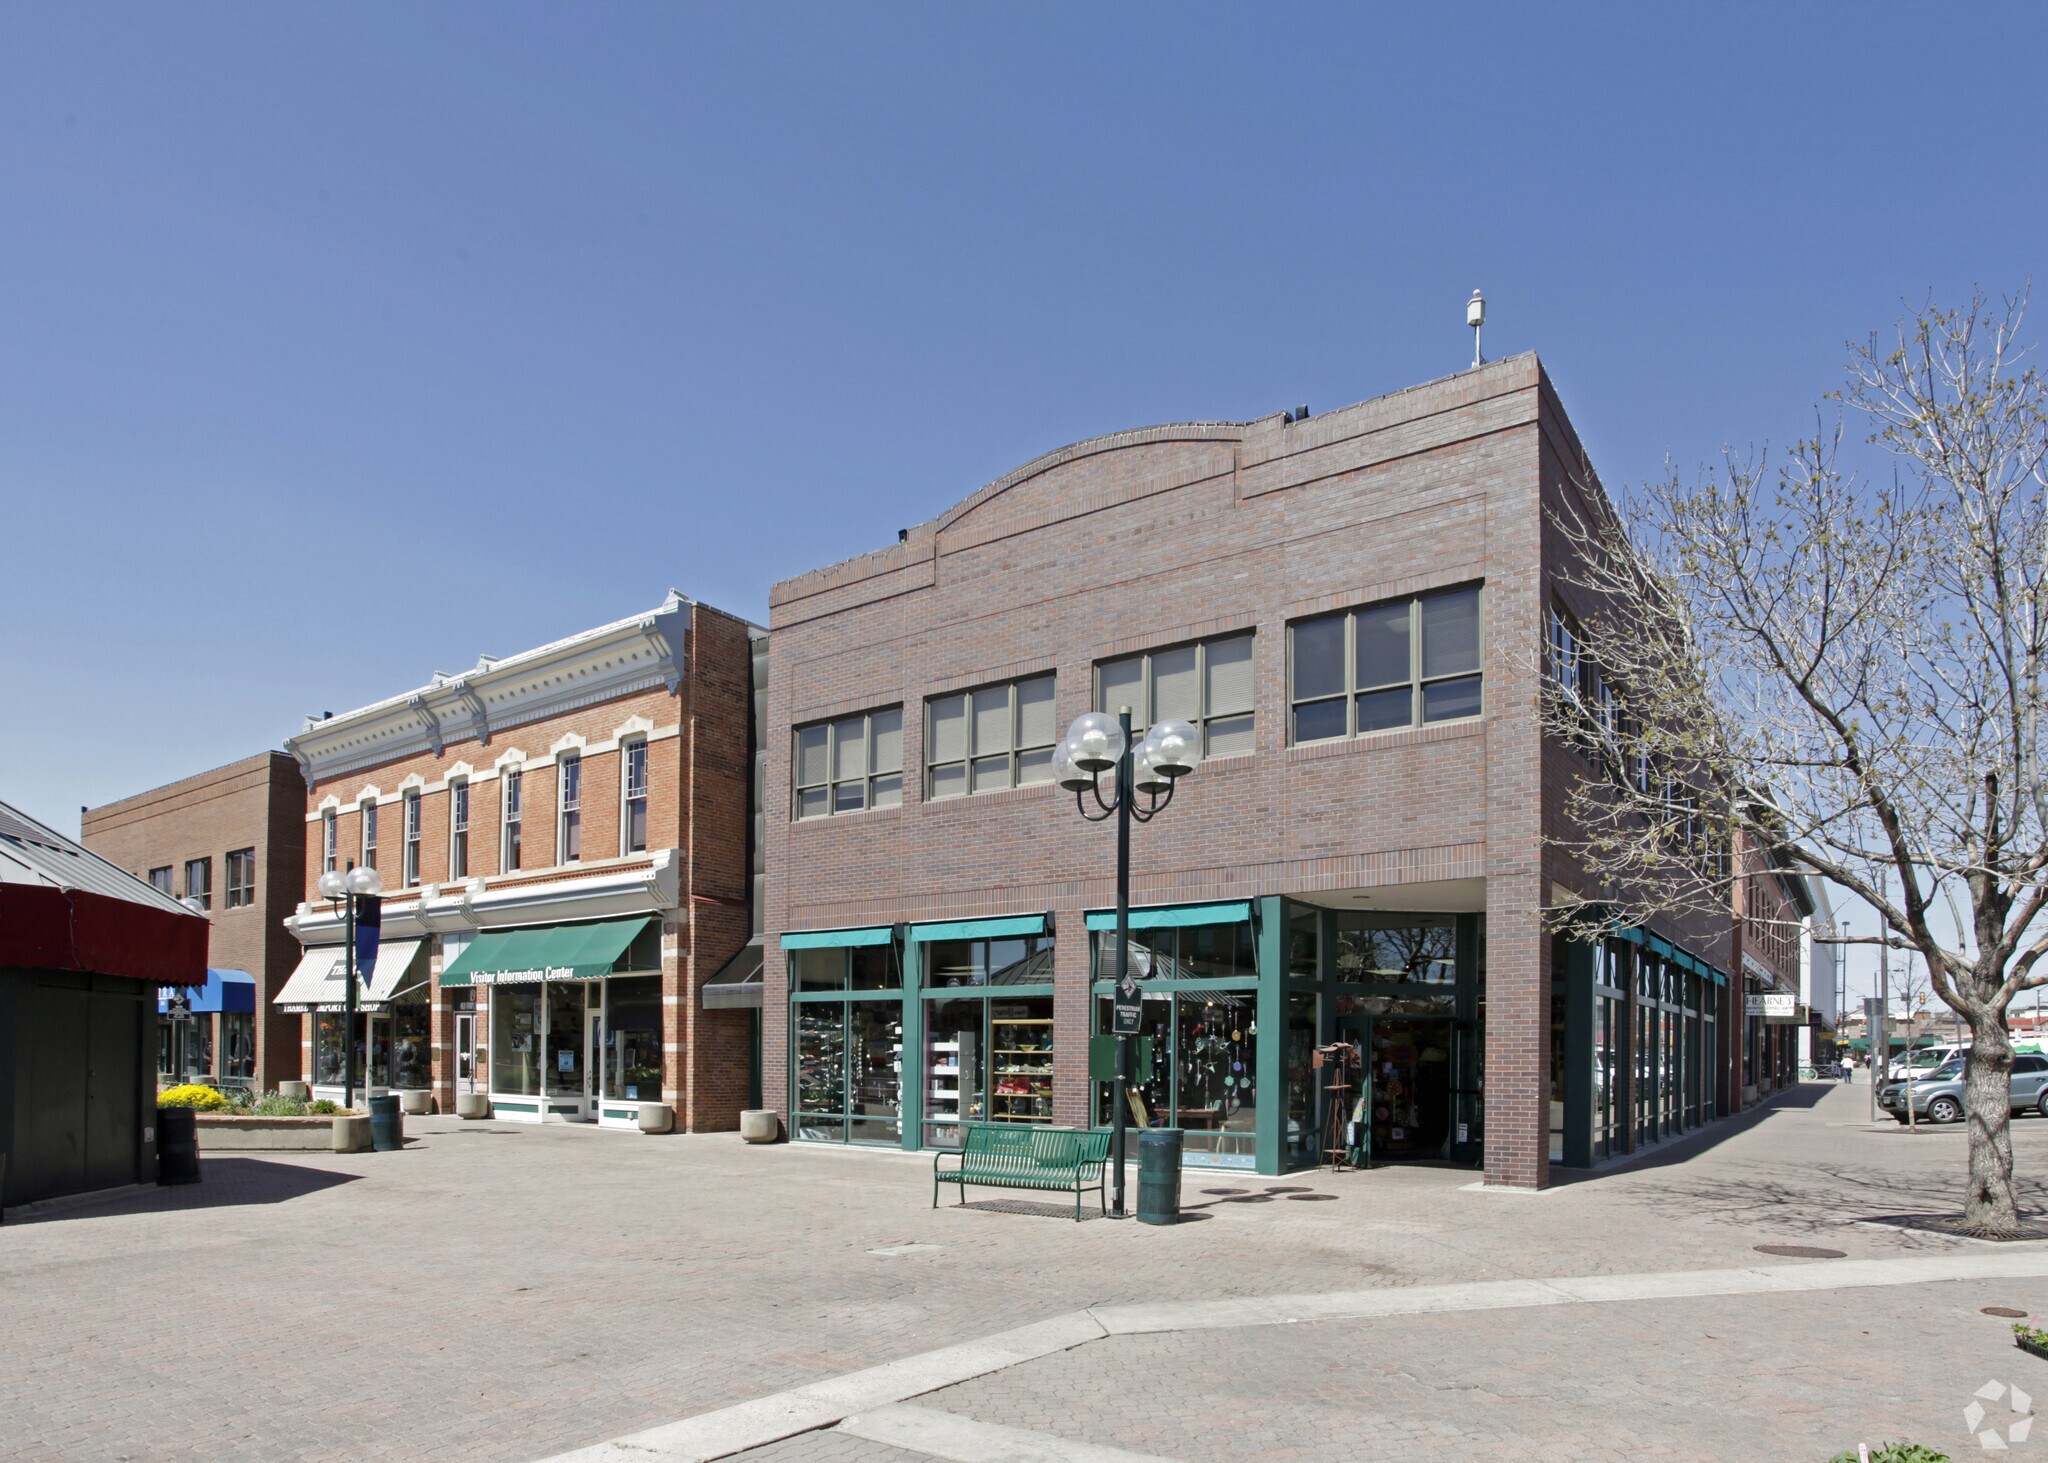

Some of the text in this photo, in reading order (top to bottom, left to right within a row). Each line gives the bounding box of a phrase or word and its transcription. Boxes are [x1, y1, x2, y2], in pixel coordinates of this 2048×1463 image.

[470, 966, 574, 984] Visitor Information Center
[1746, 996, 1793, 1005] HEARNE'S
[1116, 1004, 1140, 1012] PEDESTRIAN
